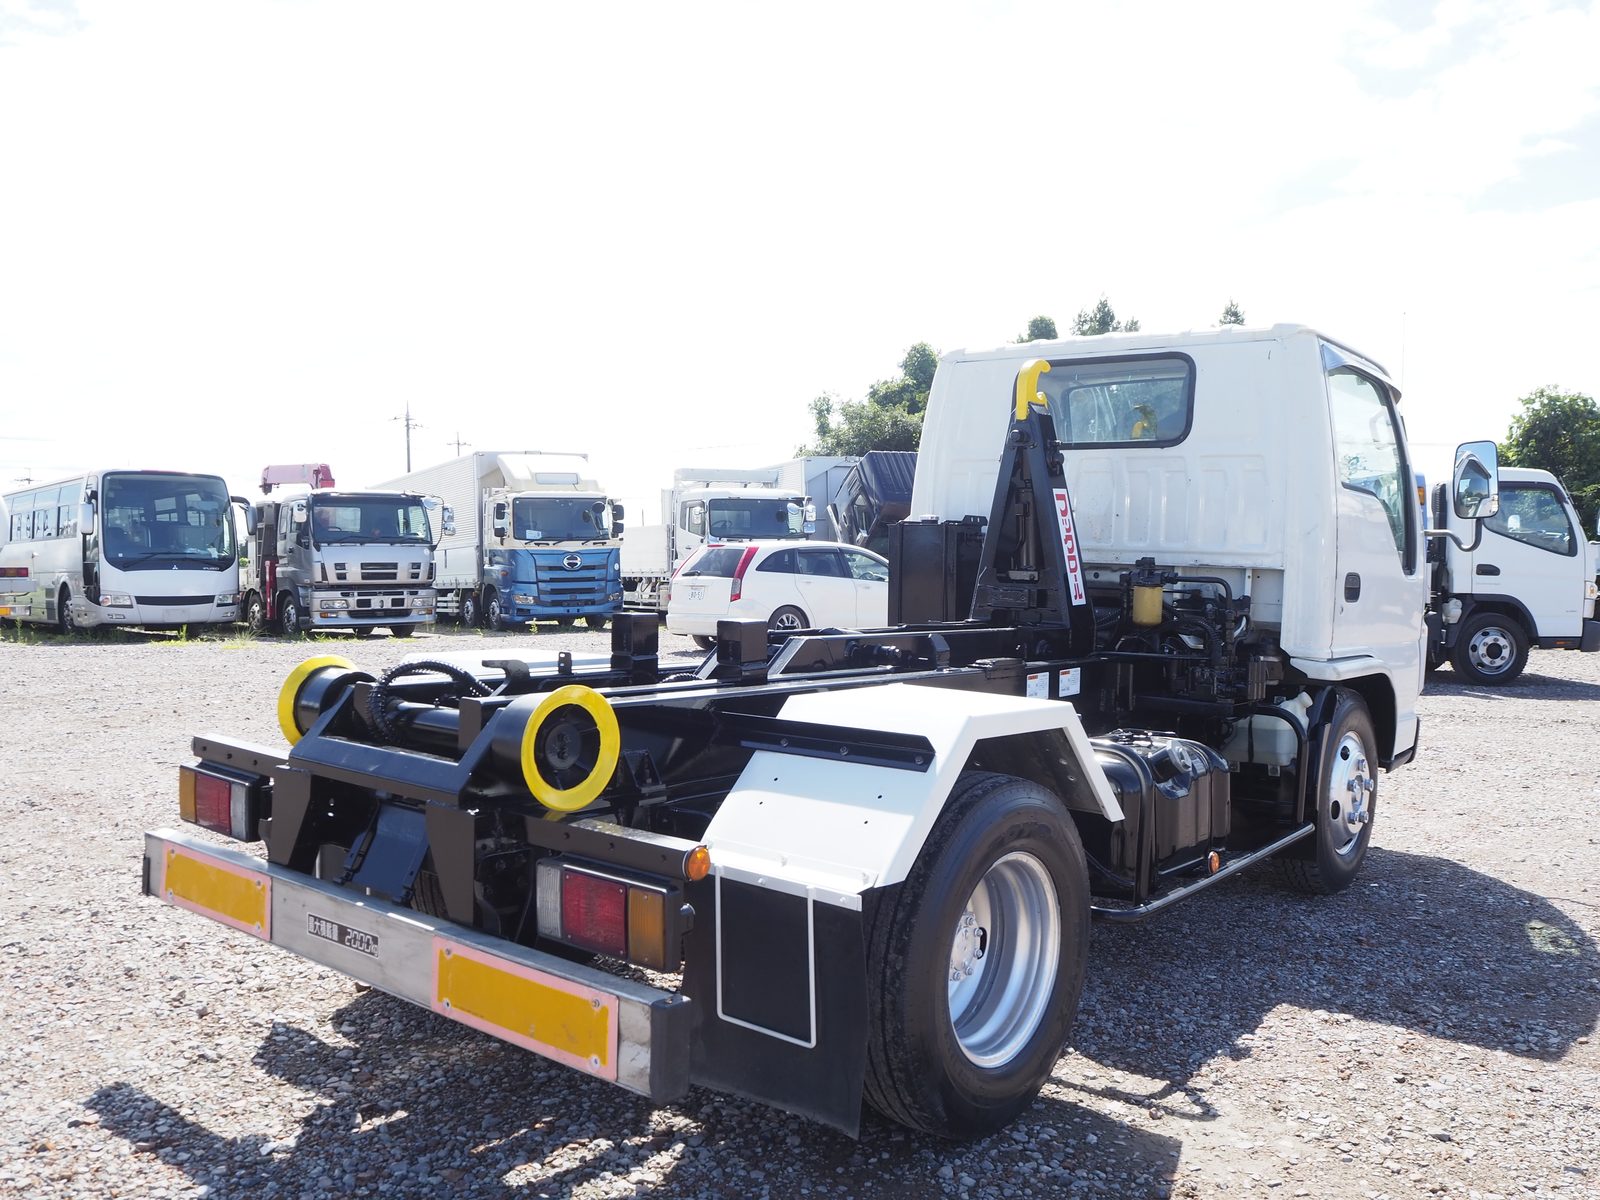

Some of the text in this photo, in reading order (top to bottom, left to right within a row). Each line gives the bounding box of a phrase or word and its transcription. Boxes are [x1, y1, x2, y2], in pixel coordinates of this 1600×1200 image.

[1055, 494, 1083, 600] フックロール
